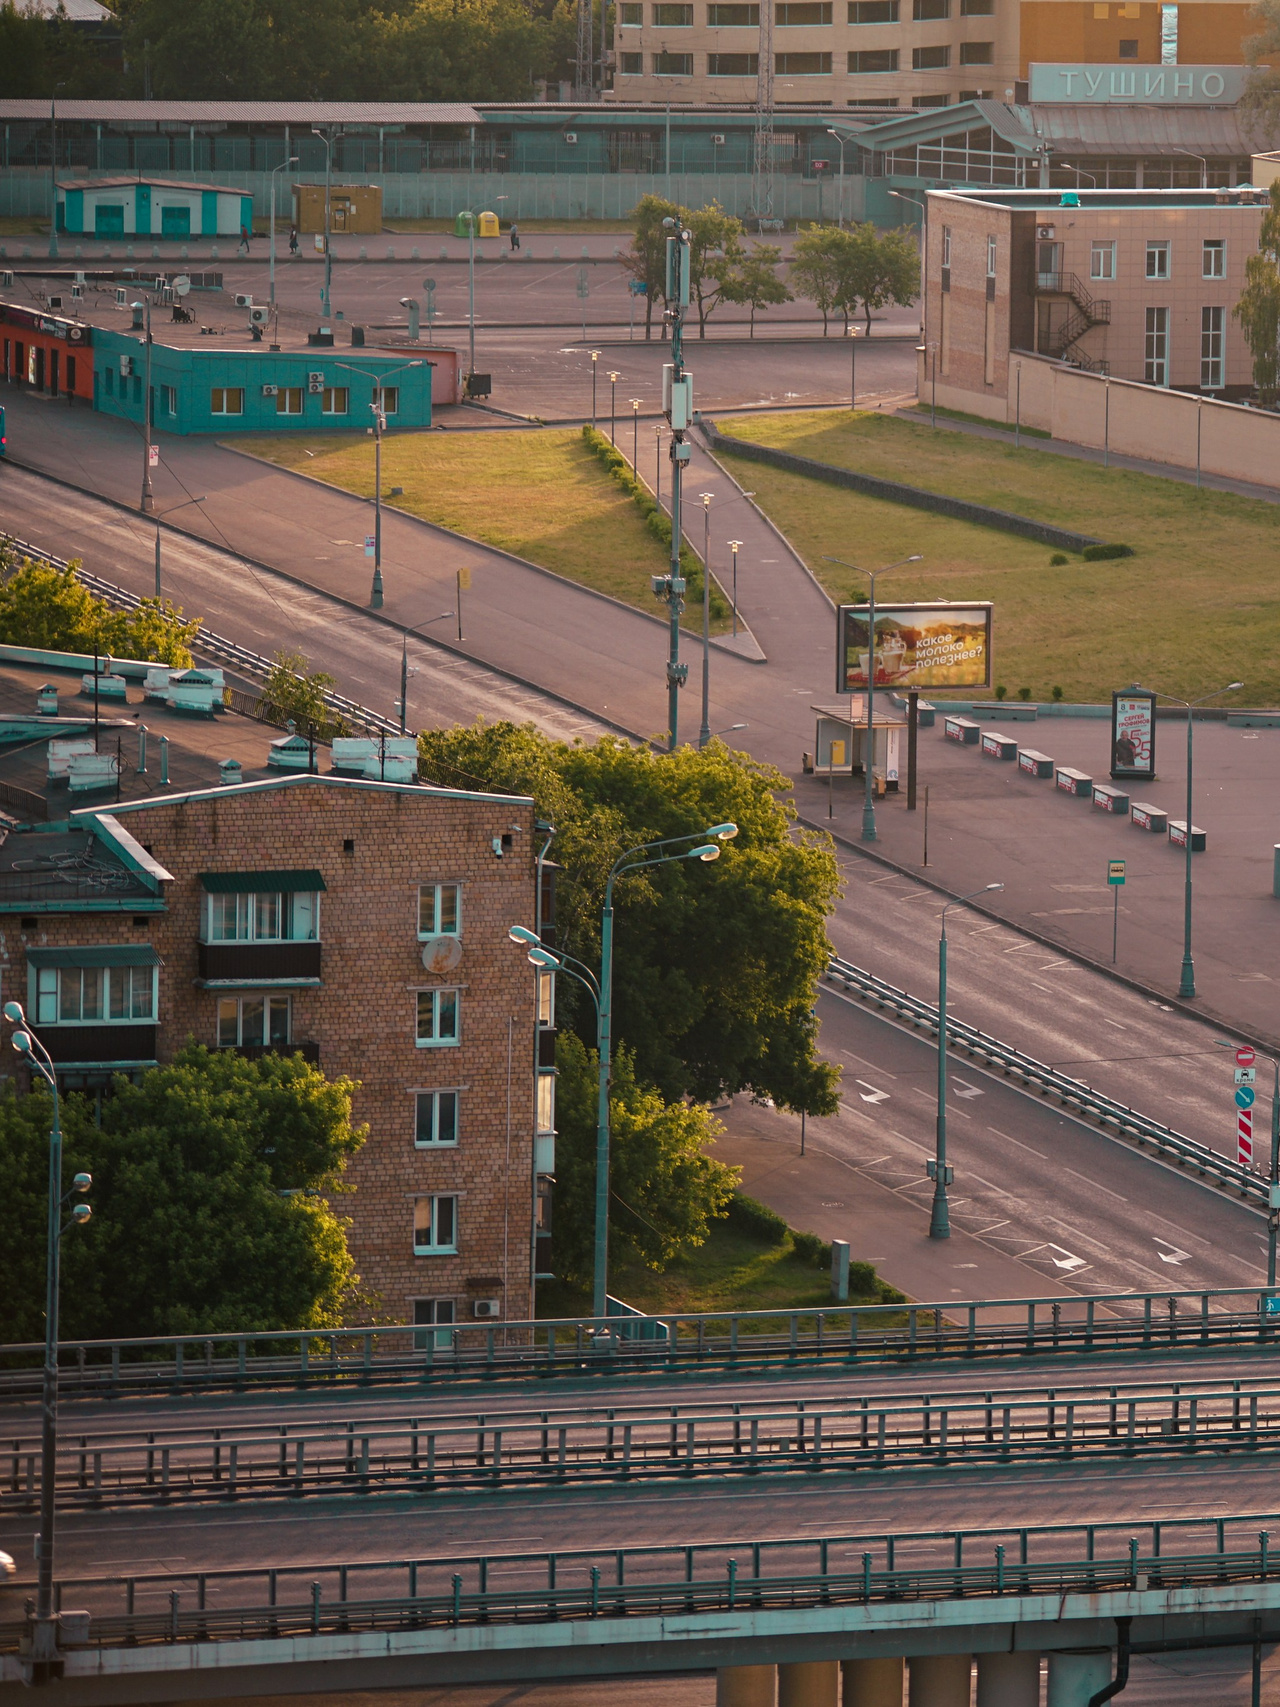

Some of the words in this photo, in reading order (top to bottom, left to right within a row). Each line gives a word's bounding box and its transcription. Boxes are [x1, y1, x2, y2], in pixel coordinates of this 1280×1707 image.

[1059, 71, 1225, 98] ТУШИНО
[916, 633, 953, 649] какое
[915, 645, 983, 669] полезнее?
[916, 642, 964, 659] молоко
[1118, 718, 1150, 728] ТРОФИМОВ
[1124, 713, 1145, 722] СЕРГЕЙ
